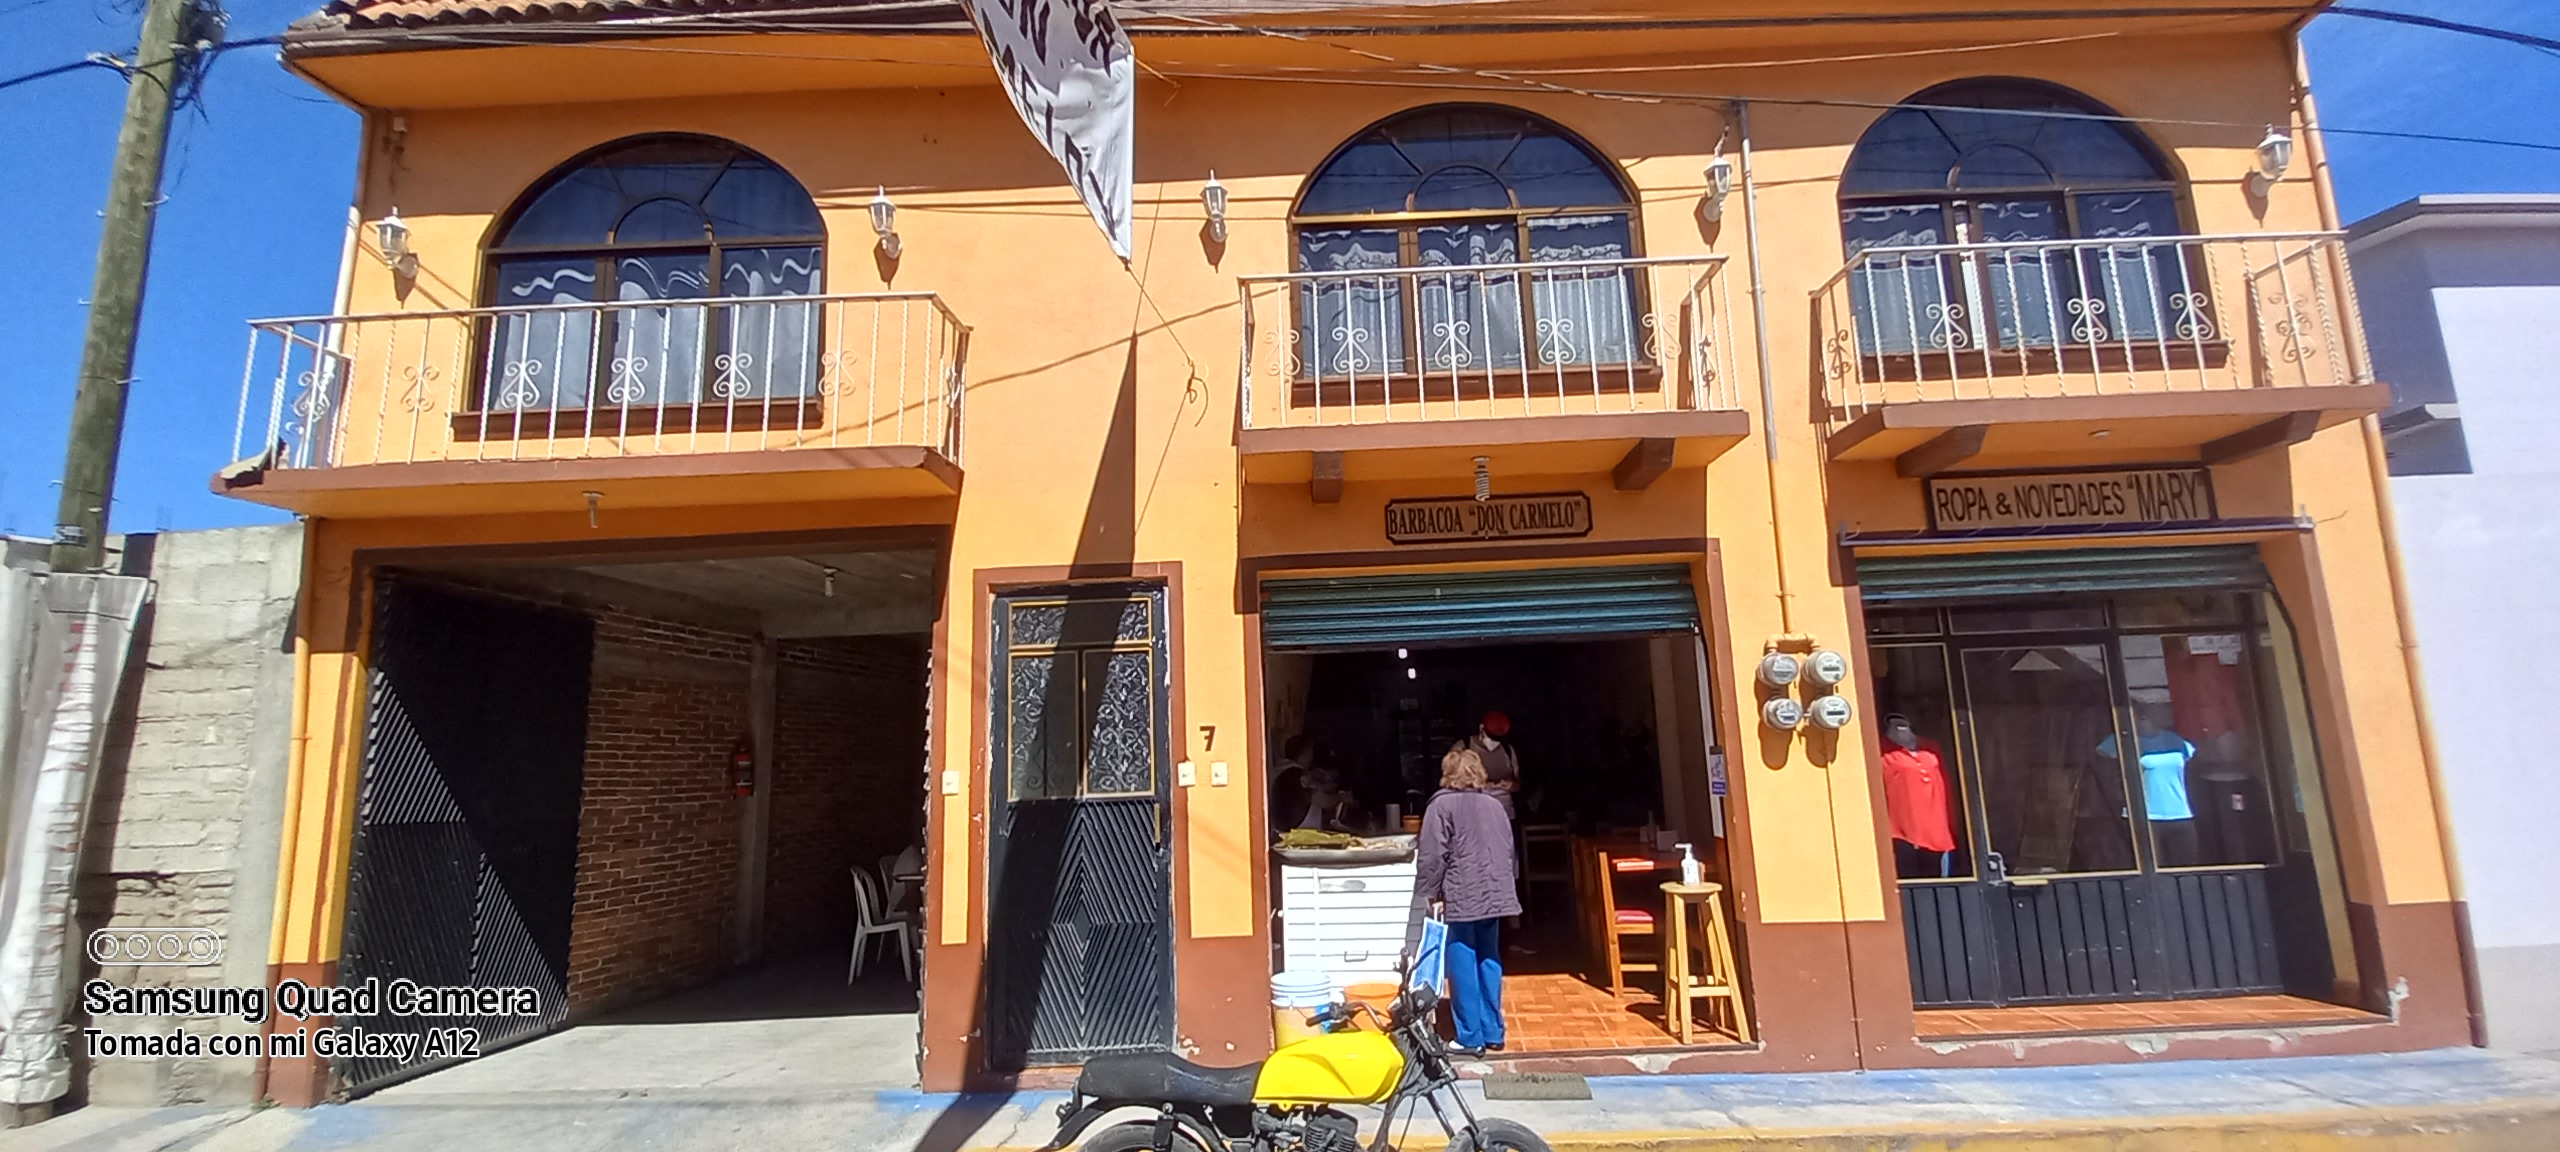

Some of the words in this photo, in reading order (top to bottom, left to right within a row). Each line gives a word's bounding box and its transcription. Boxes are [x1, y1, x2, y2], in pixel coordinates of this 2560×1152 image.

[1936, 487, 1992, 522] ROPA
[1995, 492, 2013, 515] &
[2014, 481, 2125, 519] NOVEDADES
[1388, 506, 1464, 535] BARBACOA
[1199, 725, 1216, 752] 7
